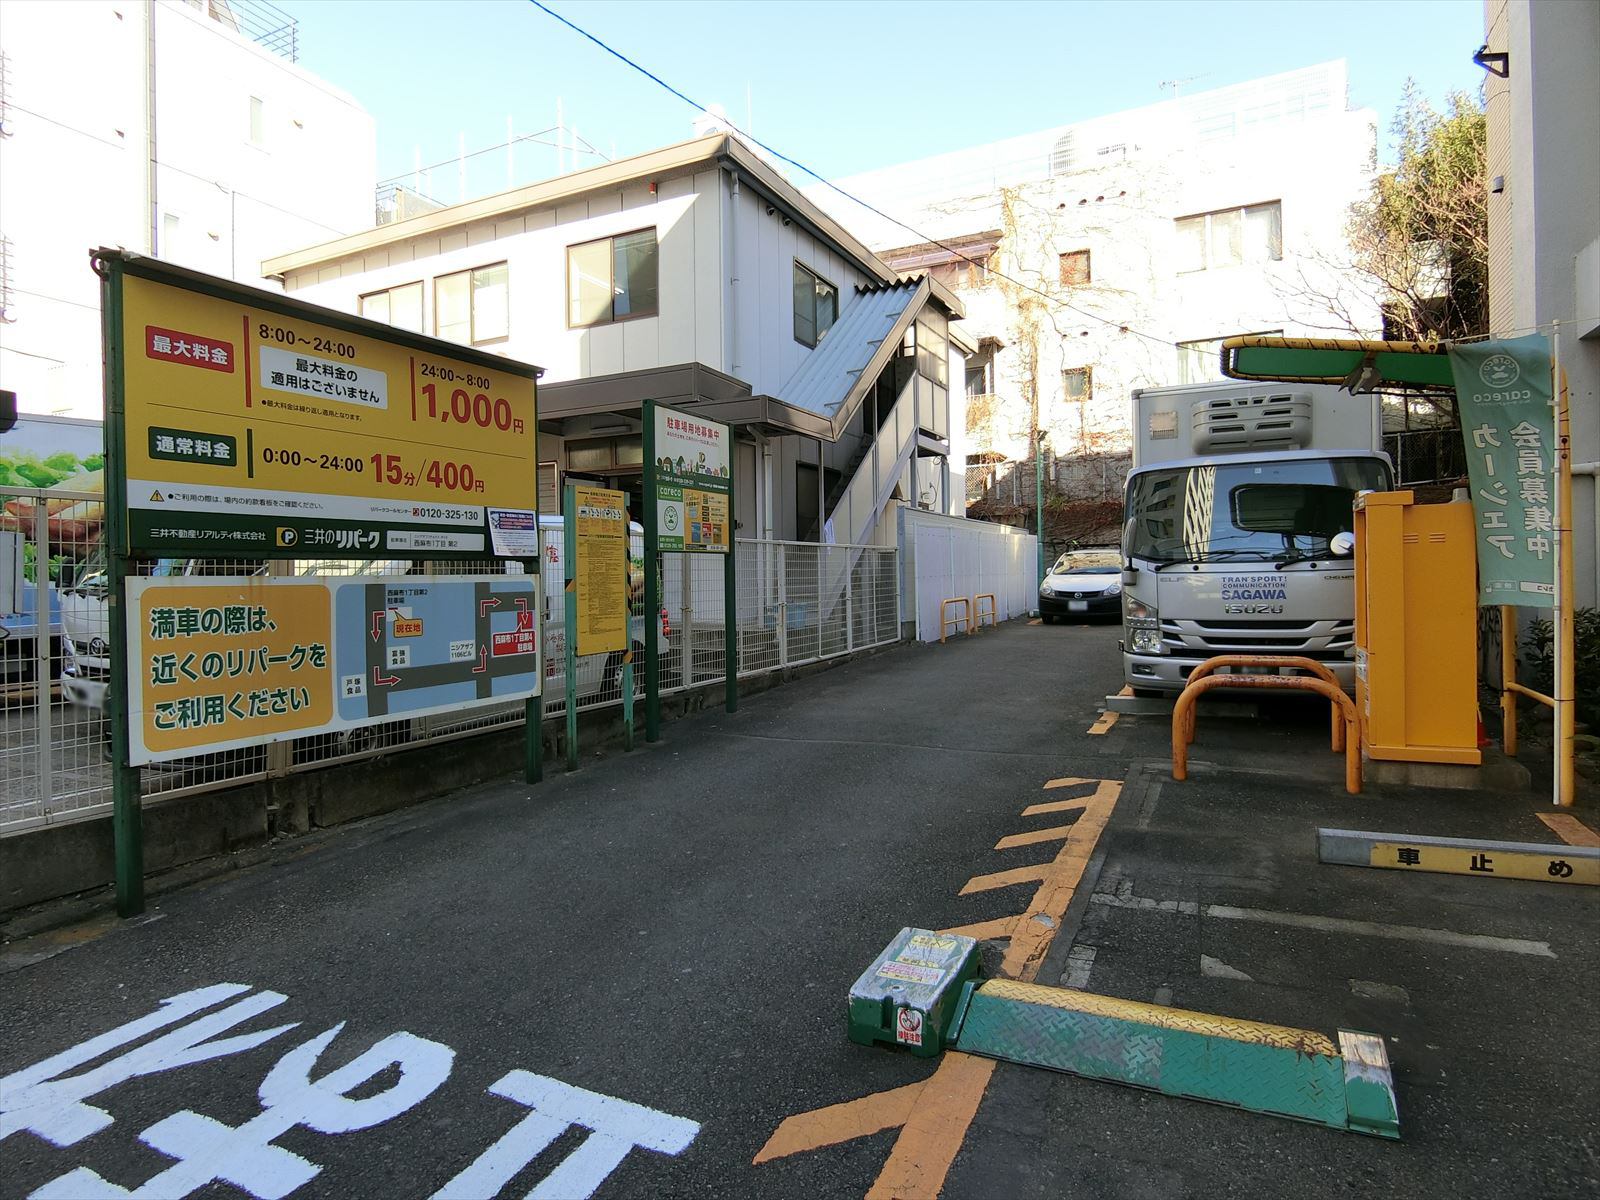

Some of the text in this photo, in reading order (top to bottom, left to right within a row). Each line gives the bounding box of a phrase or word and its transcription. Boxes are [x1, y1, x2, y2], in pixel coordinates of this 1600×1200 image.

[152, 334, 228, 365] 最大料金
[295, 358, 358, 382] 最大料金の
[271, 371, 380, 404] 適用はございません
[421, 383, 524, 435] 1,000円
[666, 416, 720, 441] 駐車場用地募集中
[156, 434, 231, 459] 通常料金
[659, 486, 682, 497] careco
[420, 507, 478, 521] 0120-325-130
[150, 528, 266, 541] 三井不動産リアルティ株式会社
[304, 528, 380, 549] 三井のリパーク
[1221, 589, 1287, 600] SAGAWA
[1225, 604, 1284, 614] ISUZU
[150, 606, 277, 640] 満車の際は、
[396, 623, 421, 634] 現在地
[151, 643, 327, 685] 近くのリパークを
[154, 687, 310, 730] ご利用ください
